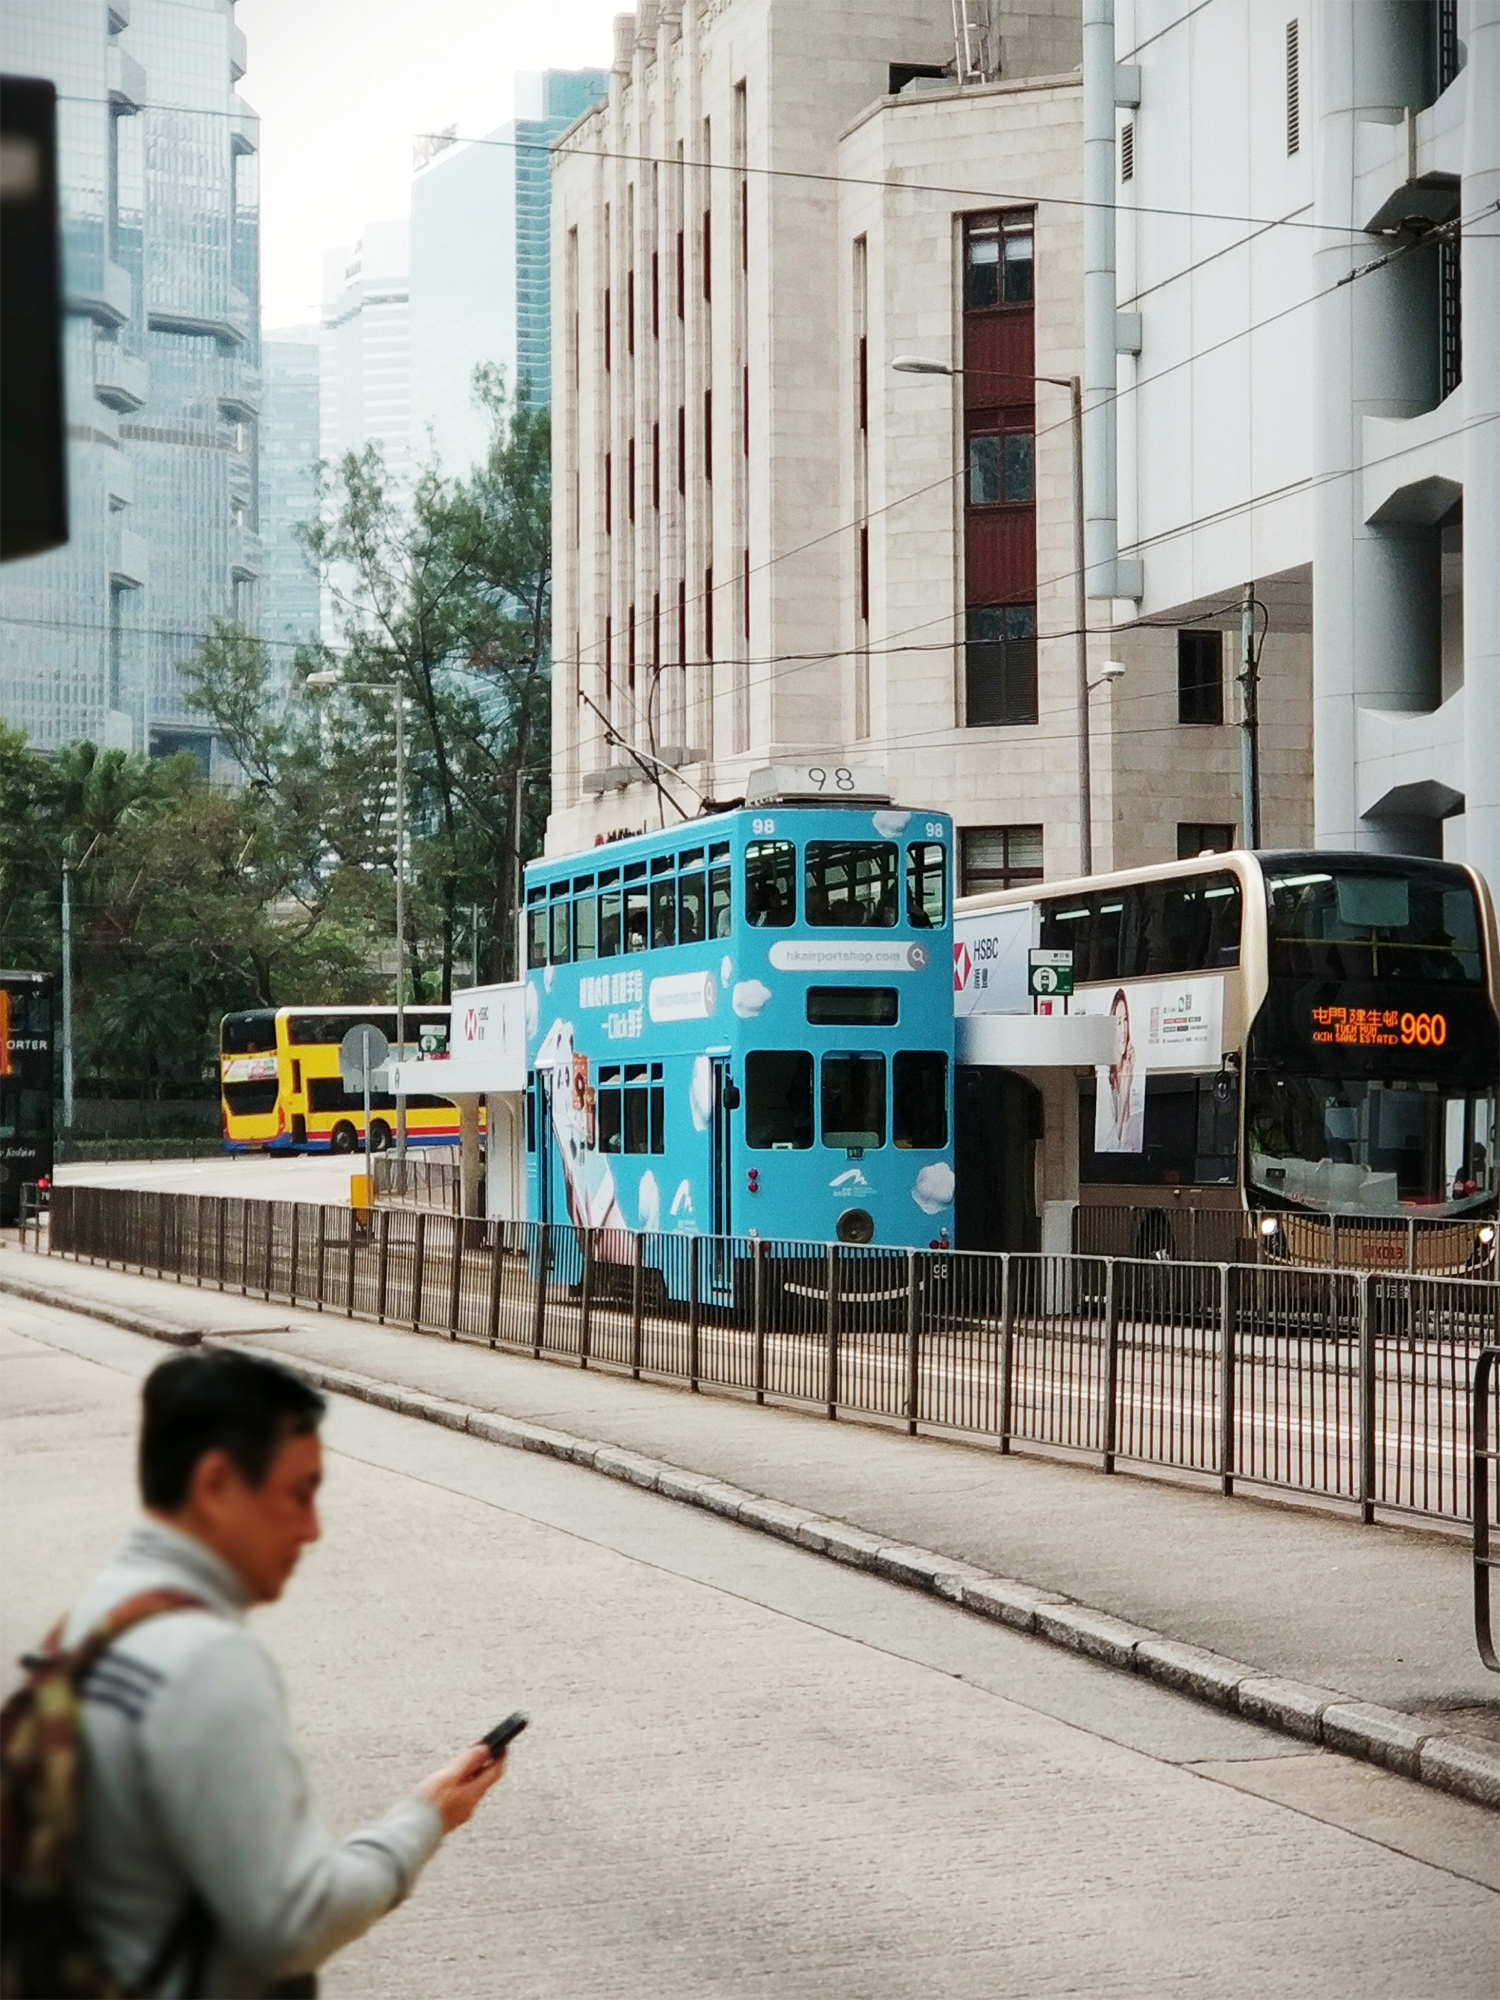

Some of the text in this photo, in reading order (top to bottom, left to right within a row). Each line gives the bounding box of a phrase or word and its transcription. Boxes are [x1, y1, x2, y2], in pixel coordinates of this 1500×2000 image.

[808, 767, 855, 791] 98
[752, 818, 775, 835] 98
[925, 822, 943, 837] 98
[786, 951, 900, 963] hkairportshop.com
[974, 937, 999, 961] HSBC
[1334, 1023, 1378, 1036] TUEN MUN
[1400, 1012, 1447, 1045] 960
[6, 1039, 48, 1051] ORTER
